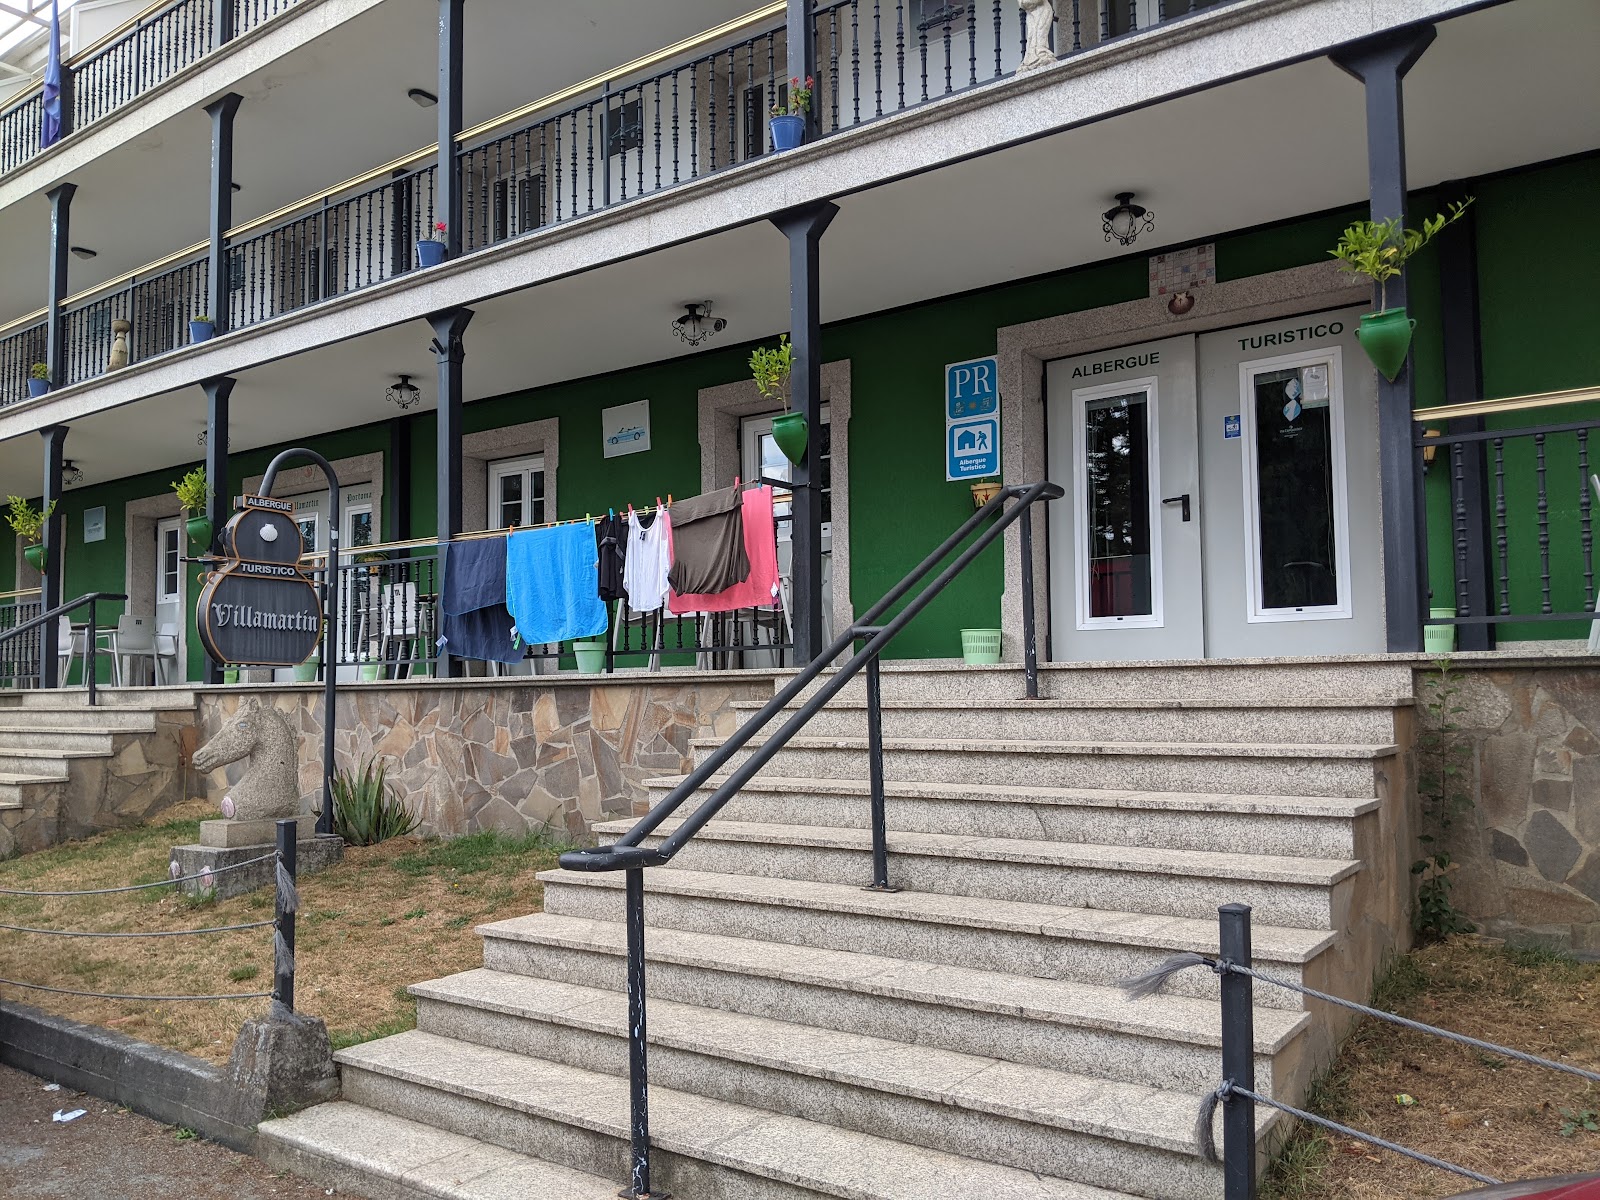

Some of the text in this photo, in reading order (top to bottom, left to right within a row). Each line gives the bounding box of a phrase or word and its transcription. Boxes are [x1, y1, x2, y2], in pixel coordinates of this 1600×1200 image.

[1071, 321, 1344, 379] ALBERGUE TURISTICO
[954, 364, 992, 398] PR
[959, 457, 986, 466] Albergue
[247, 497, 292, 511] ALBERGUE
[240, 562, 296, 576] TURISTICO
